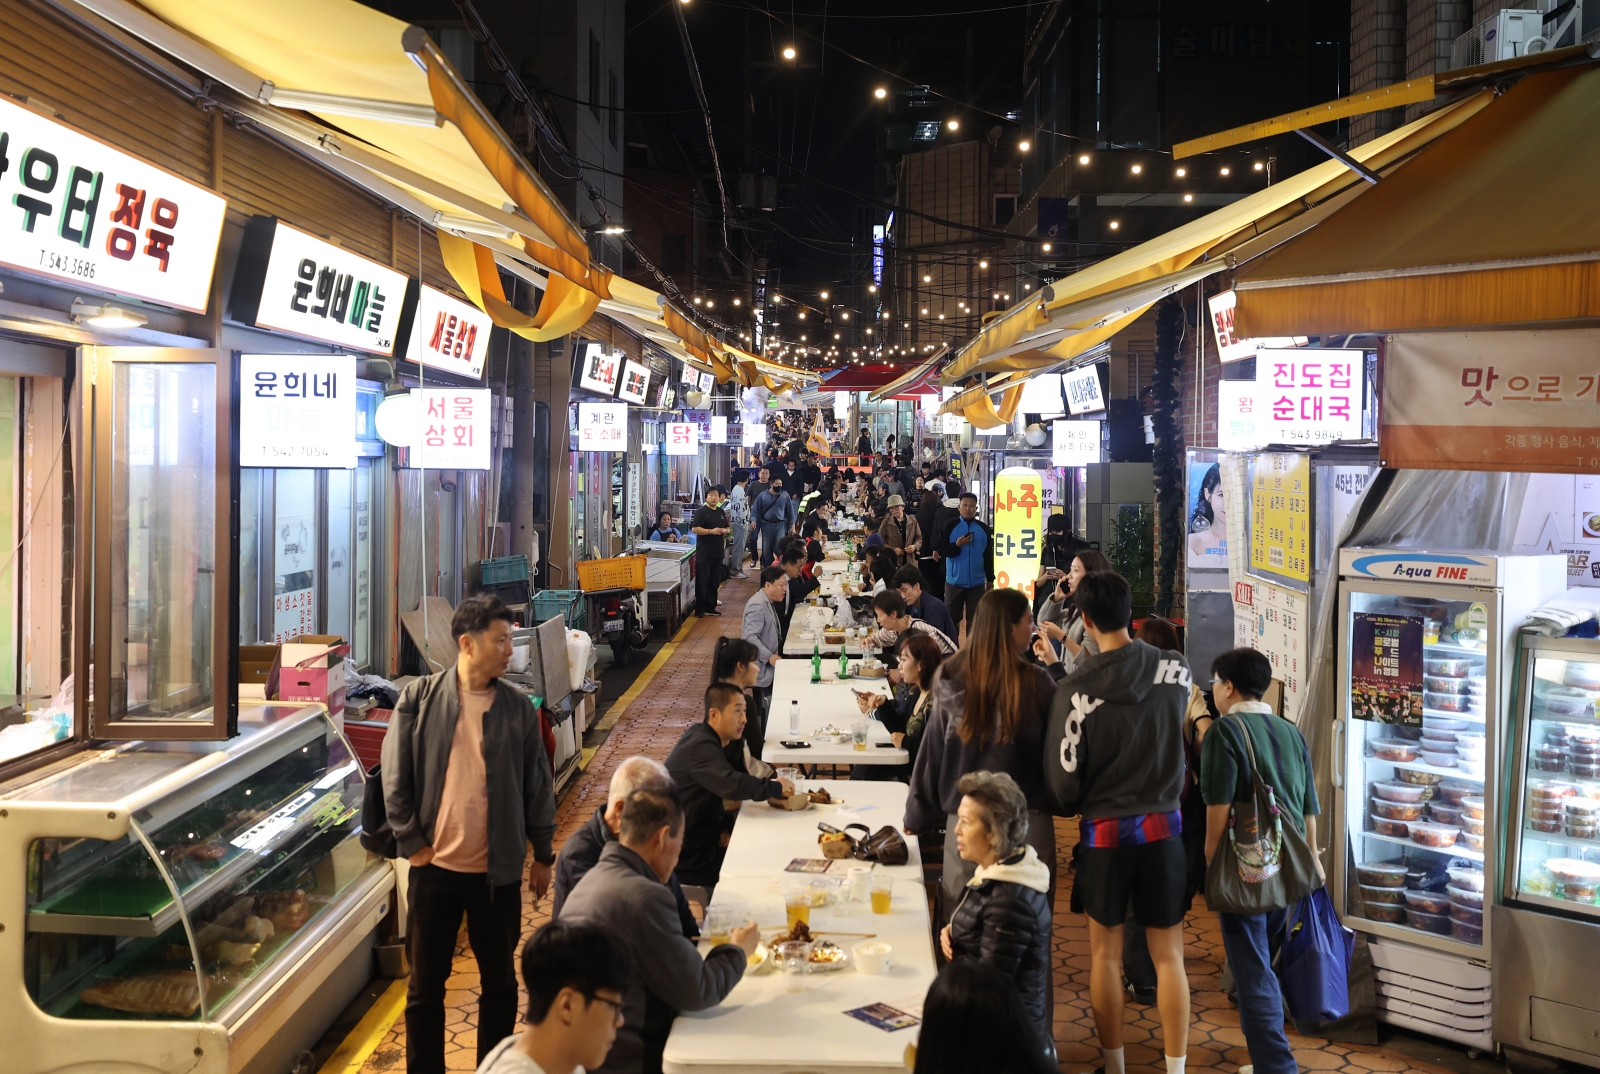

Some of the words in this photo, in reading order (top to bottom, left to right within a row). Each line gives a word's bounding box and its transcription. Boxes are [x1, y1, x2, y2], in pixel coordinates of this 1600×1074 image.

[106, 183, 179, 272] 정육
[429, 310, 478, 362] 서울상회
[254, 371, 336, 398] 윤희네
[1273, 363, 1351, 389] 진도집
[1462, 366, 1562, 406] 맛으로
[427, 397, 474, 420] 서울
[1238, 396, 1254, 413] 왕
[1272, 395, 1350, 422] 순대국
[590, 412, 614, 424] 계란
[425, 425, 474, 446] 상회
[672, 425, 691, 444] 닭
[1505, 434, 1526, 448] 각종
[1532, 434, 1554, 449] 행사
[1335, 474, 1352, 494] 45년
[996, 484, 1039, 518] 사주
[996, 529, 1038, 558] 타로
[1393, 564, 1432, 578] Aqua
[1436, 566, 1468, 580] FINE
[1237, 584, 1251, 605] SALE
[1374, 628, 1400, 637] K-시장
[1374, 637, 1399, 647] 글로벌
[1374, 657, 1399, 667] 나이트
[1374, 666, 1382, 675] in
